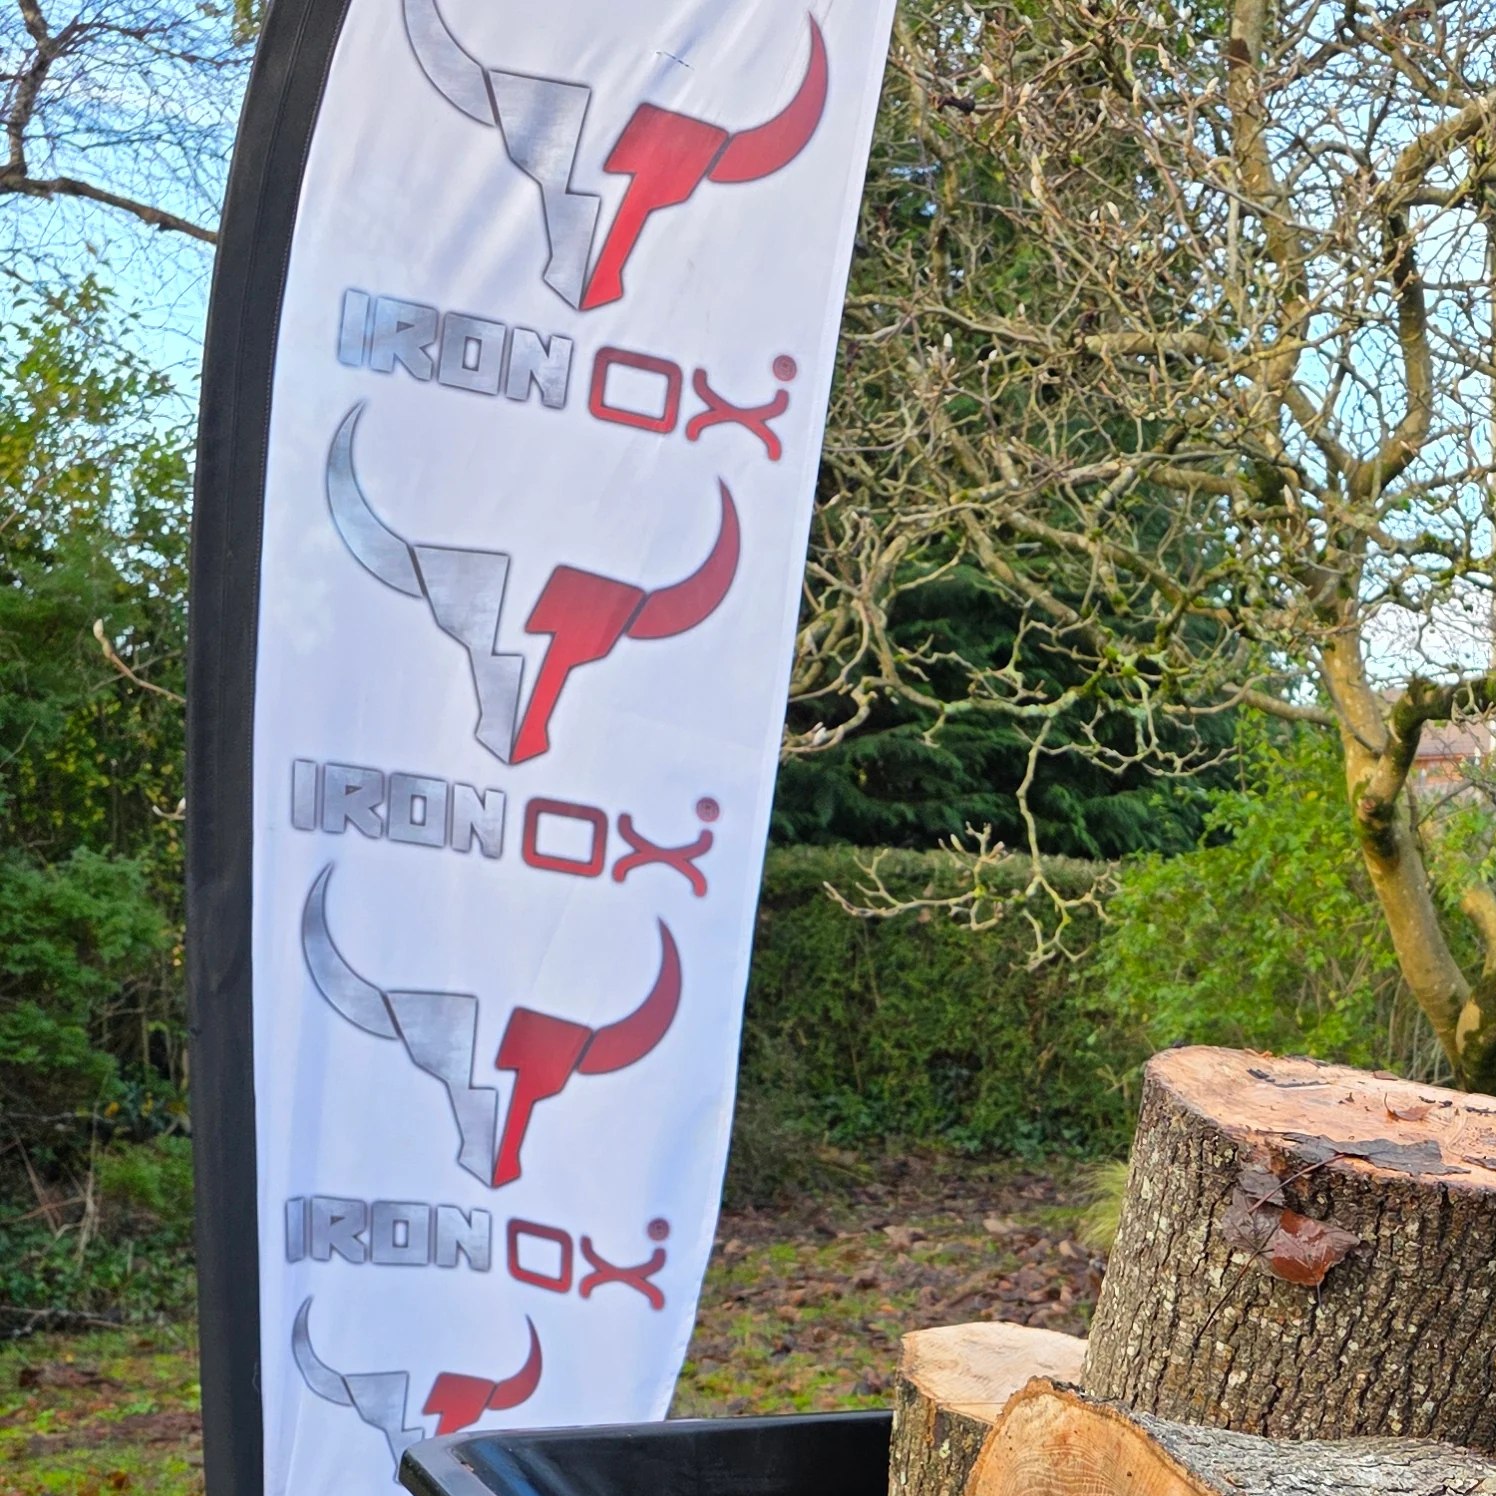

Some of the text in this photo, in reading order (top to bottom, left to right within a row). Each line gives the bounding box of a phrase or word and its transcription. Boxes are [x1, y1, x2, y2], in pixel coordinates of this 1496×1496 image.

[336, 288, 574, 410] IRON
[290, 758, 506, 860] IRON
[284, 1195, 492, 1272] IRON
